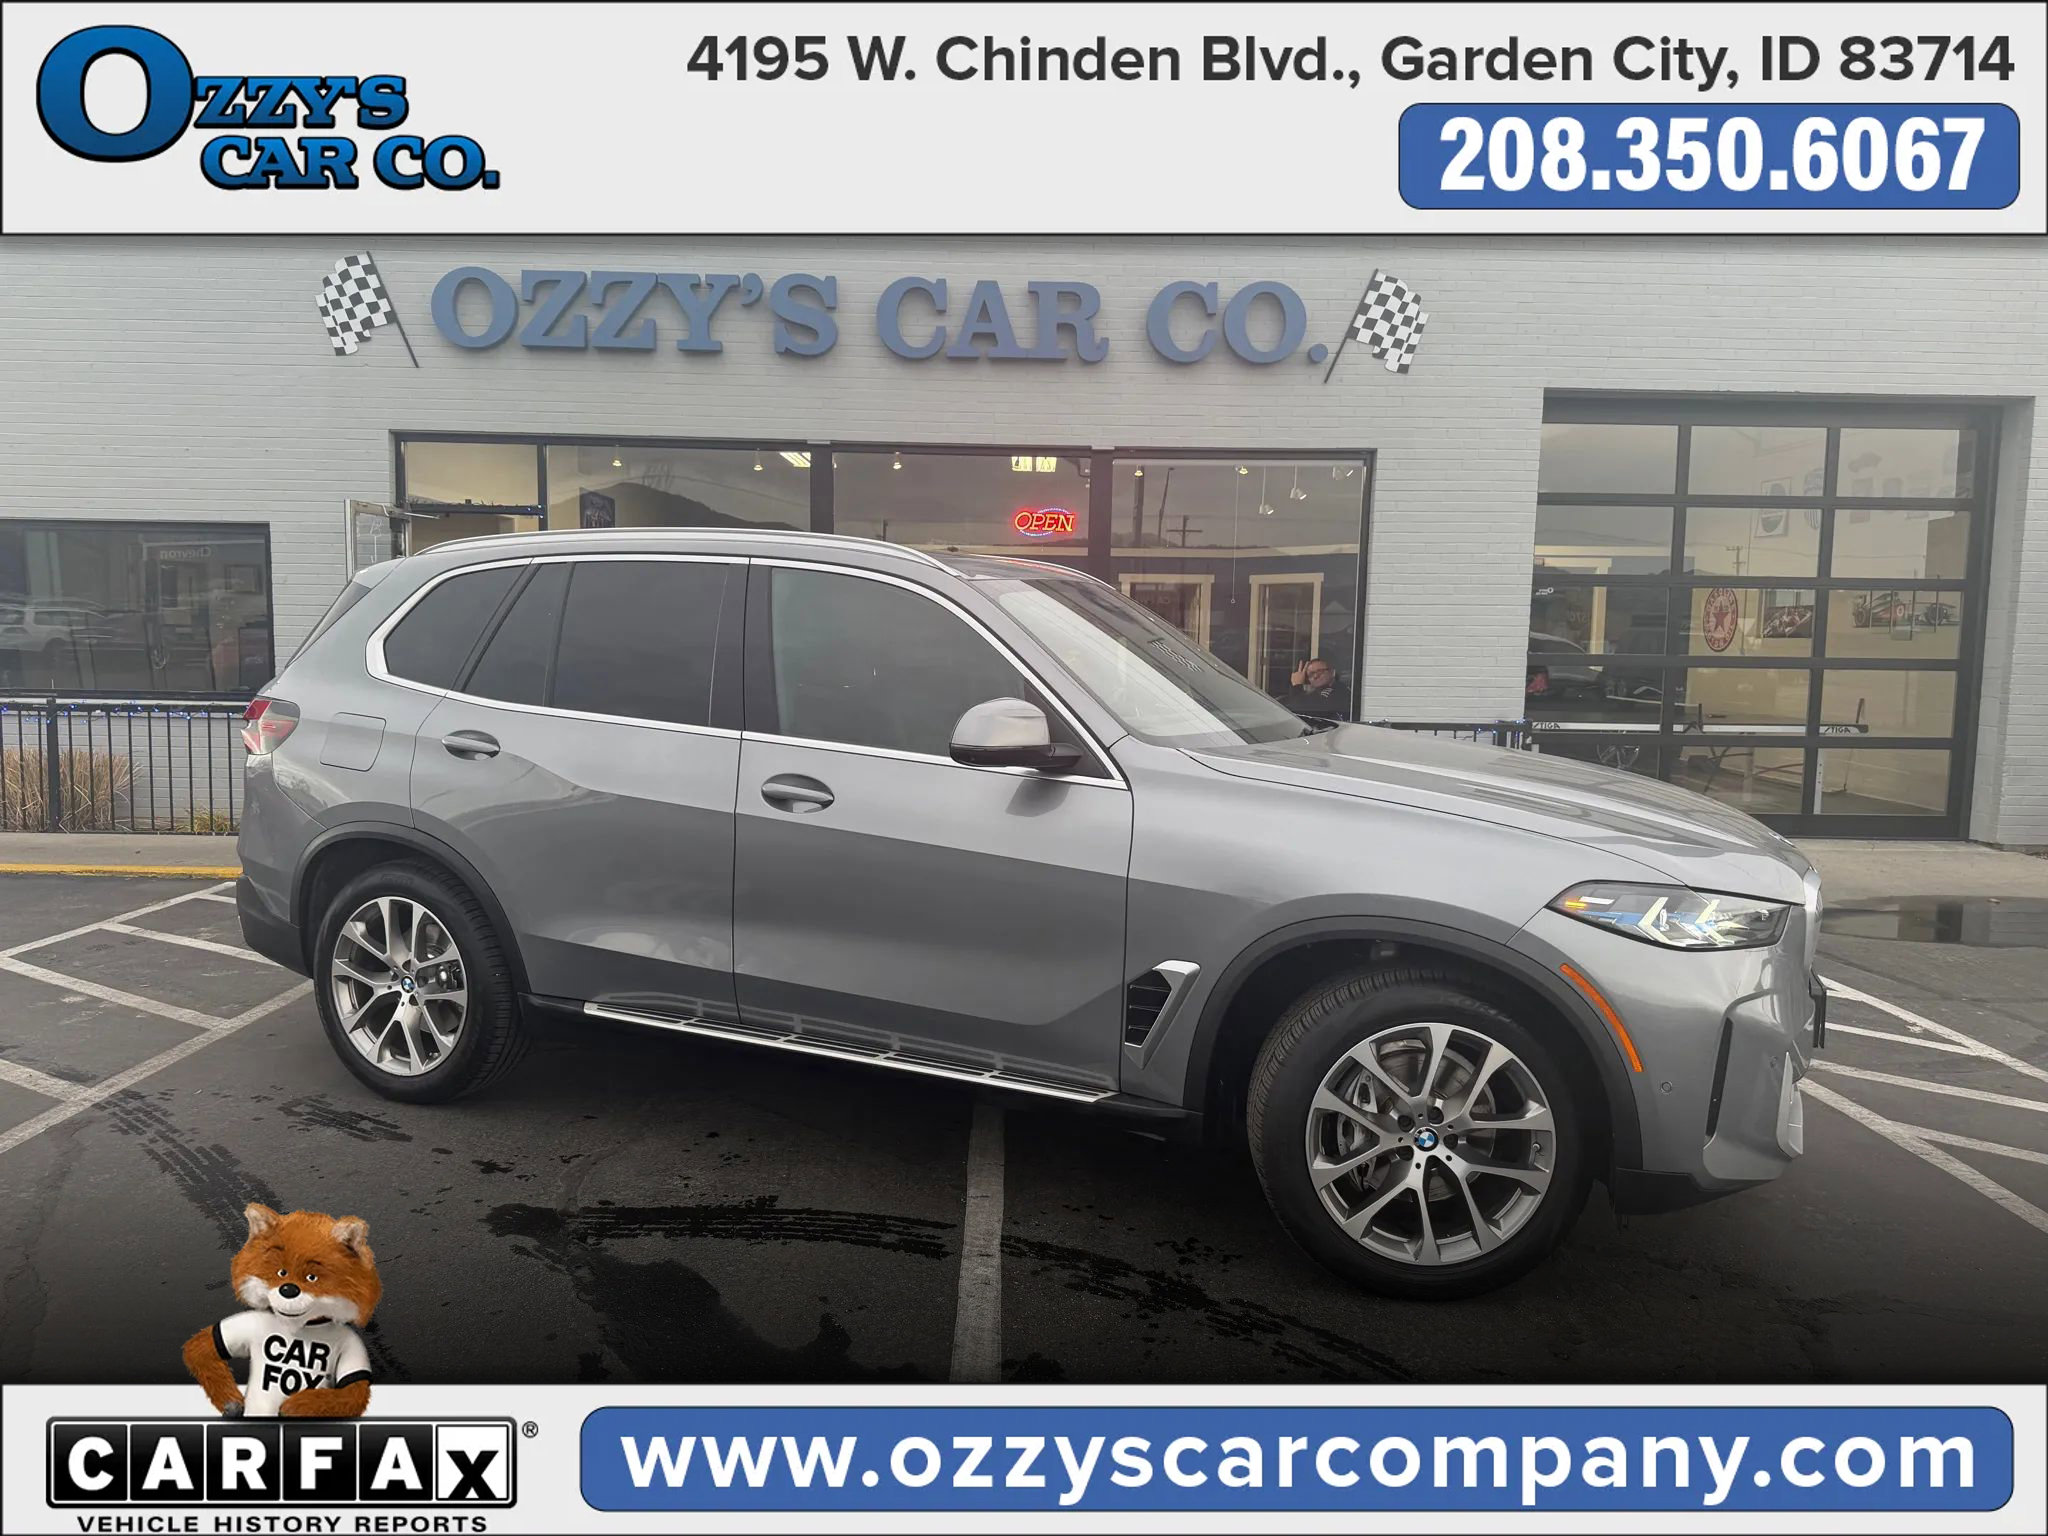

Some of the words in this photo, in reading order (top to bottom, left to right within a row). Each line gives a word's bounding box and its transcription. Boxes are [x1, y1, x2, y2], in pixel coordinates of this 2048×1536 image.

[432, 268, 836, 354] OZZY’S
[878, 277, 1107, 362] CAR
[1147, 281, 1328, 364] CO.
[1015, 512, 1075, 531] OPEN
